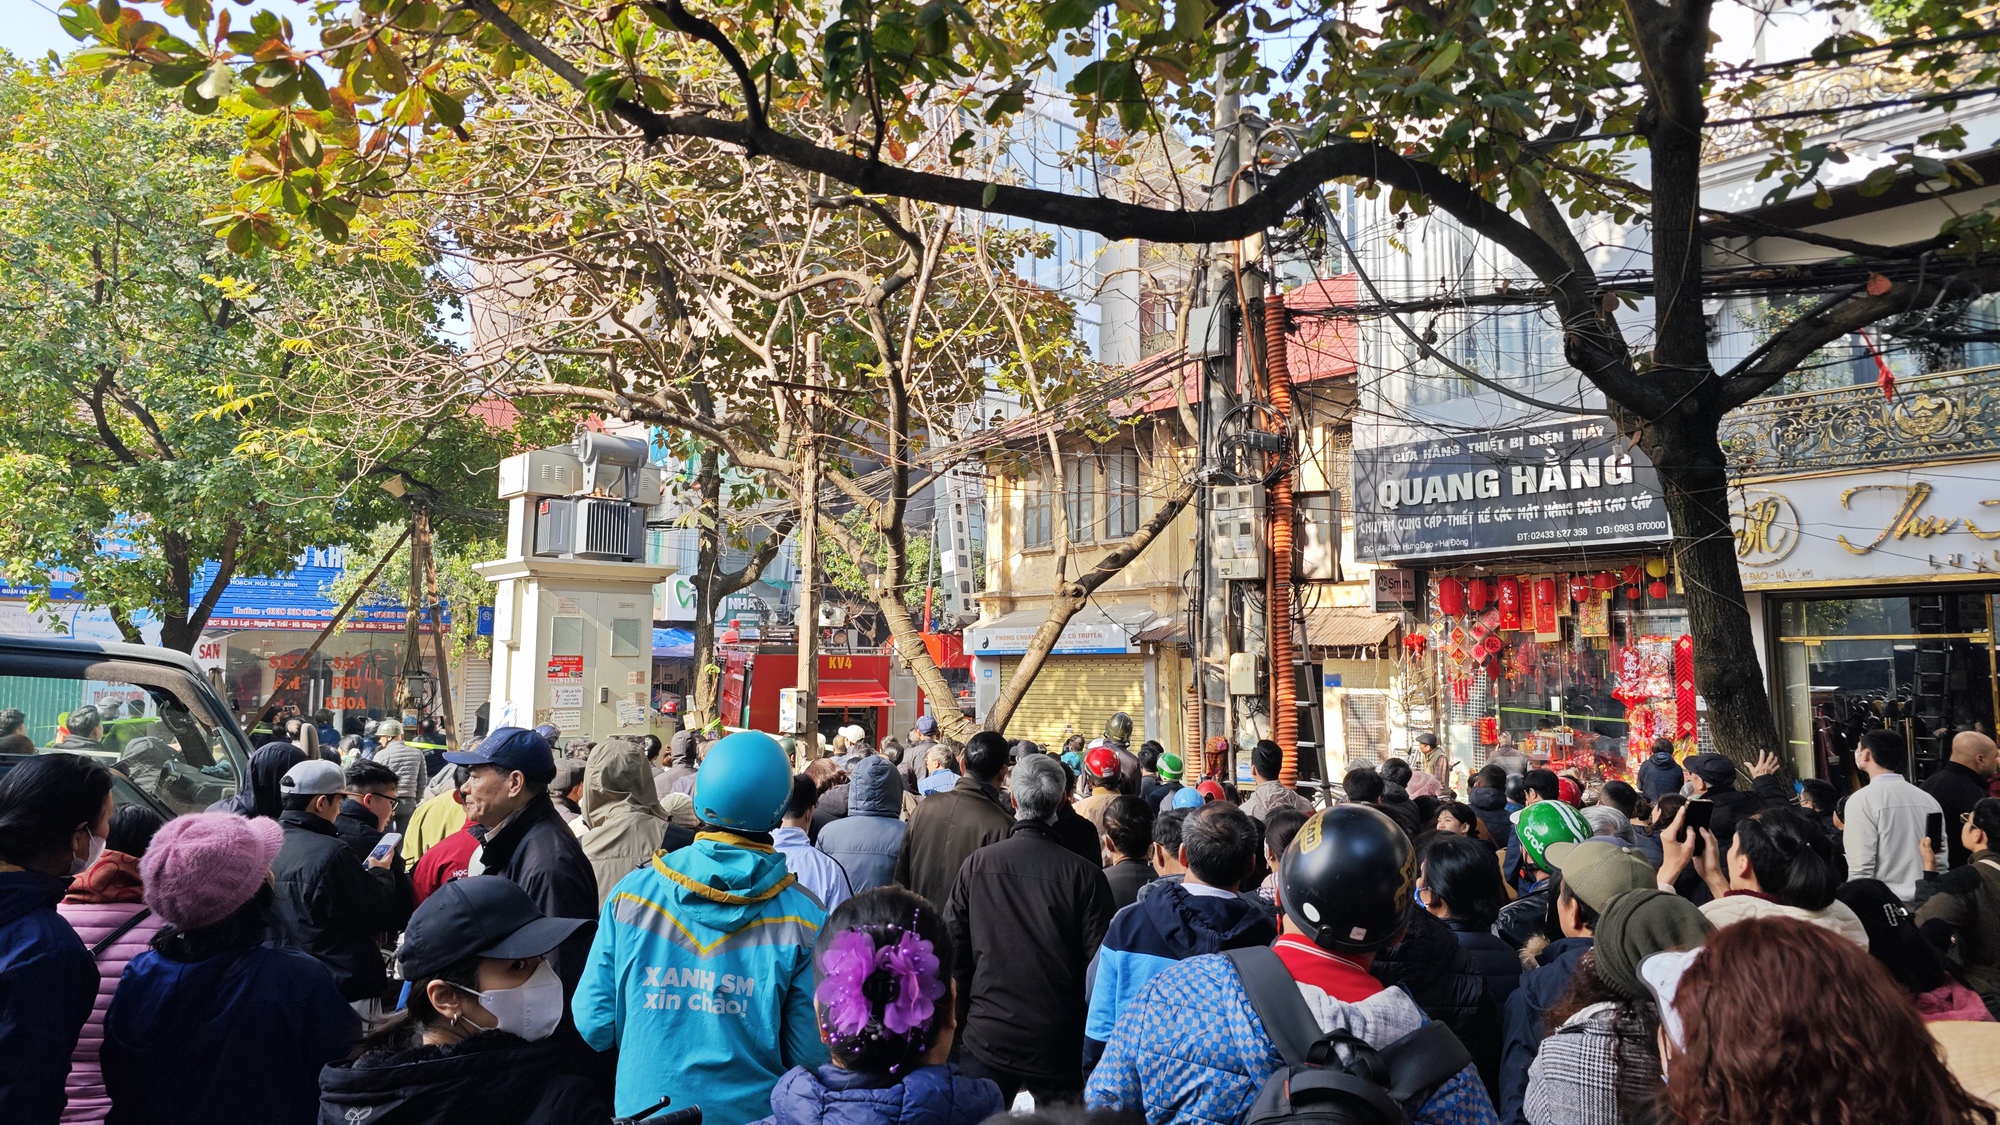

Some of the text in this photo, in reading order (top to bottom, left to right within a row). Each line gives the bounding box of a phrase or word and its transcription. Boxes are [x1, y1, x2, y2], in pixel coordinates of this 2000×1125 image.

[1392, 423, 1605, 463] CỬA HÀNG THIẾT BỊ ĐIỆN MÁY
[1378, 448, 1633, 511] QUANG HẰNG
[1397, 515, 1421, 531] CUNG
[1478, 506, 1491, 524] KẾ
[1493, 506, 1512, 523] CÁC
[1517, 503, 1540, 522] MẶT
[1543, 500, 1573, 520] HÀNG
[1604, 496, 1627, 514] CAO
[1631, 490, 1653, 511] CẤP
[1573, 527, 1588, 537] 358
[1614, 523, 1634, 533] 0983
[1636, 520, 1666, 531] 870000
[1450, 537, 1469, 549] Đông
[1775, 568, 1788, 579] HÀ
[233, 606, 260, 616] Hotline
[333, 650, 363, 669] SẢN
[828, 656, 852, 669] KV4
[332, 676, 361, 693] PHỤ
[325, 696, 367, 710] KHOA
[1523, 826, 1545, 855] Grab
[642, 966, 755, 998] XANH SM
[643, 989, 748, 1018] xin chào!
